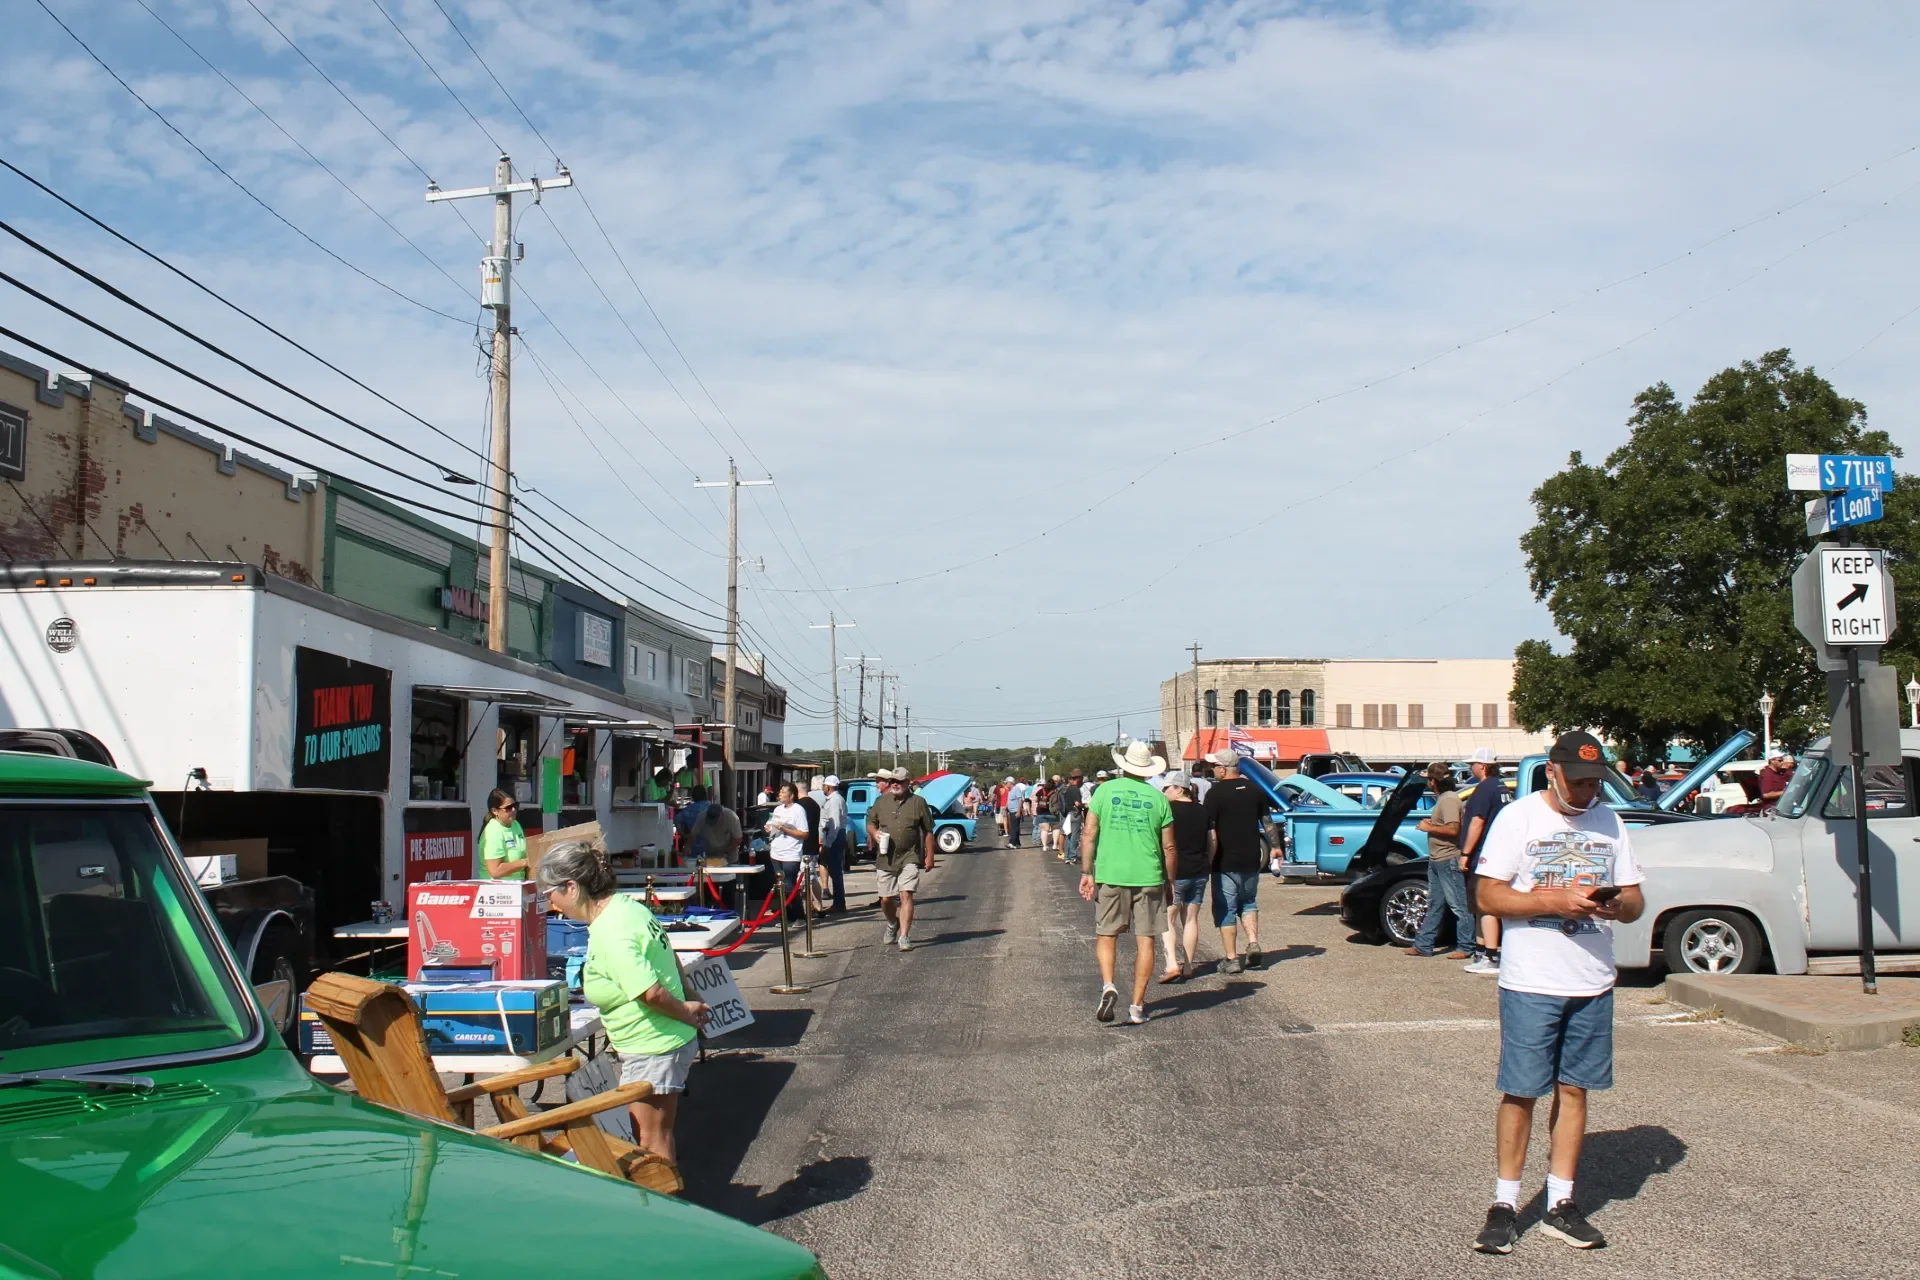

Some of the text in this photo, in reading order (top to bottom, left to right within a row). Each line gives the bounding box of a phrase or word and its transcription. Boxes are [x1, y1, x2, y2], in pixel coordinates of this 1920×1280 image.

[1824, 460, 1886, 486] S 7TH St
[1829, 500, 1838, 525] E
[1841, 496, 1872, 522] Leon
[1871, 487, 1880, 501] St
[1831, 557, 1875, 574] KEEP
[1832, 618, 1881, 635] RIGHT
[313, 684, 373, 728] THANK YOU
[304, 723, 382, 766] TO OUR SPONSORS
[410, 836, 465, 862] PRE-REGISTRATION
[416, 892, 470, 905] Bauer
[478, 895, 495, 905] 4.5
[478, 907, 485, 917] 9
[454, 1033, 488, 1041] CARLYLE
